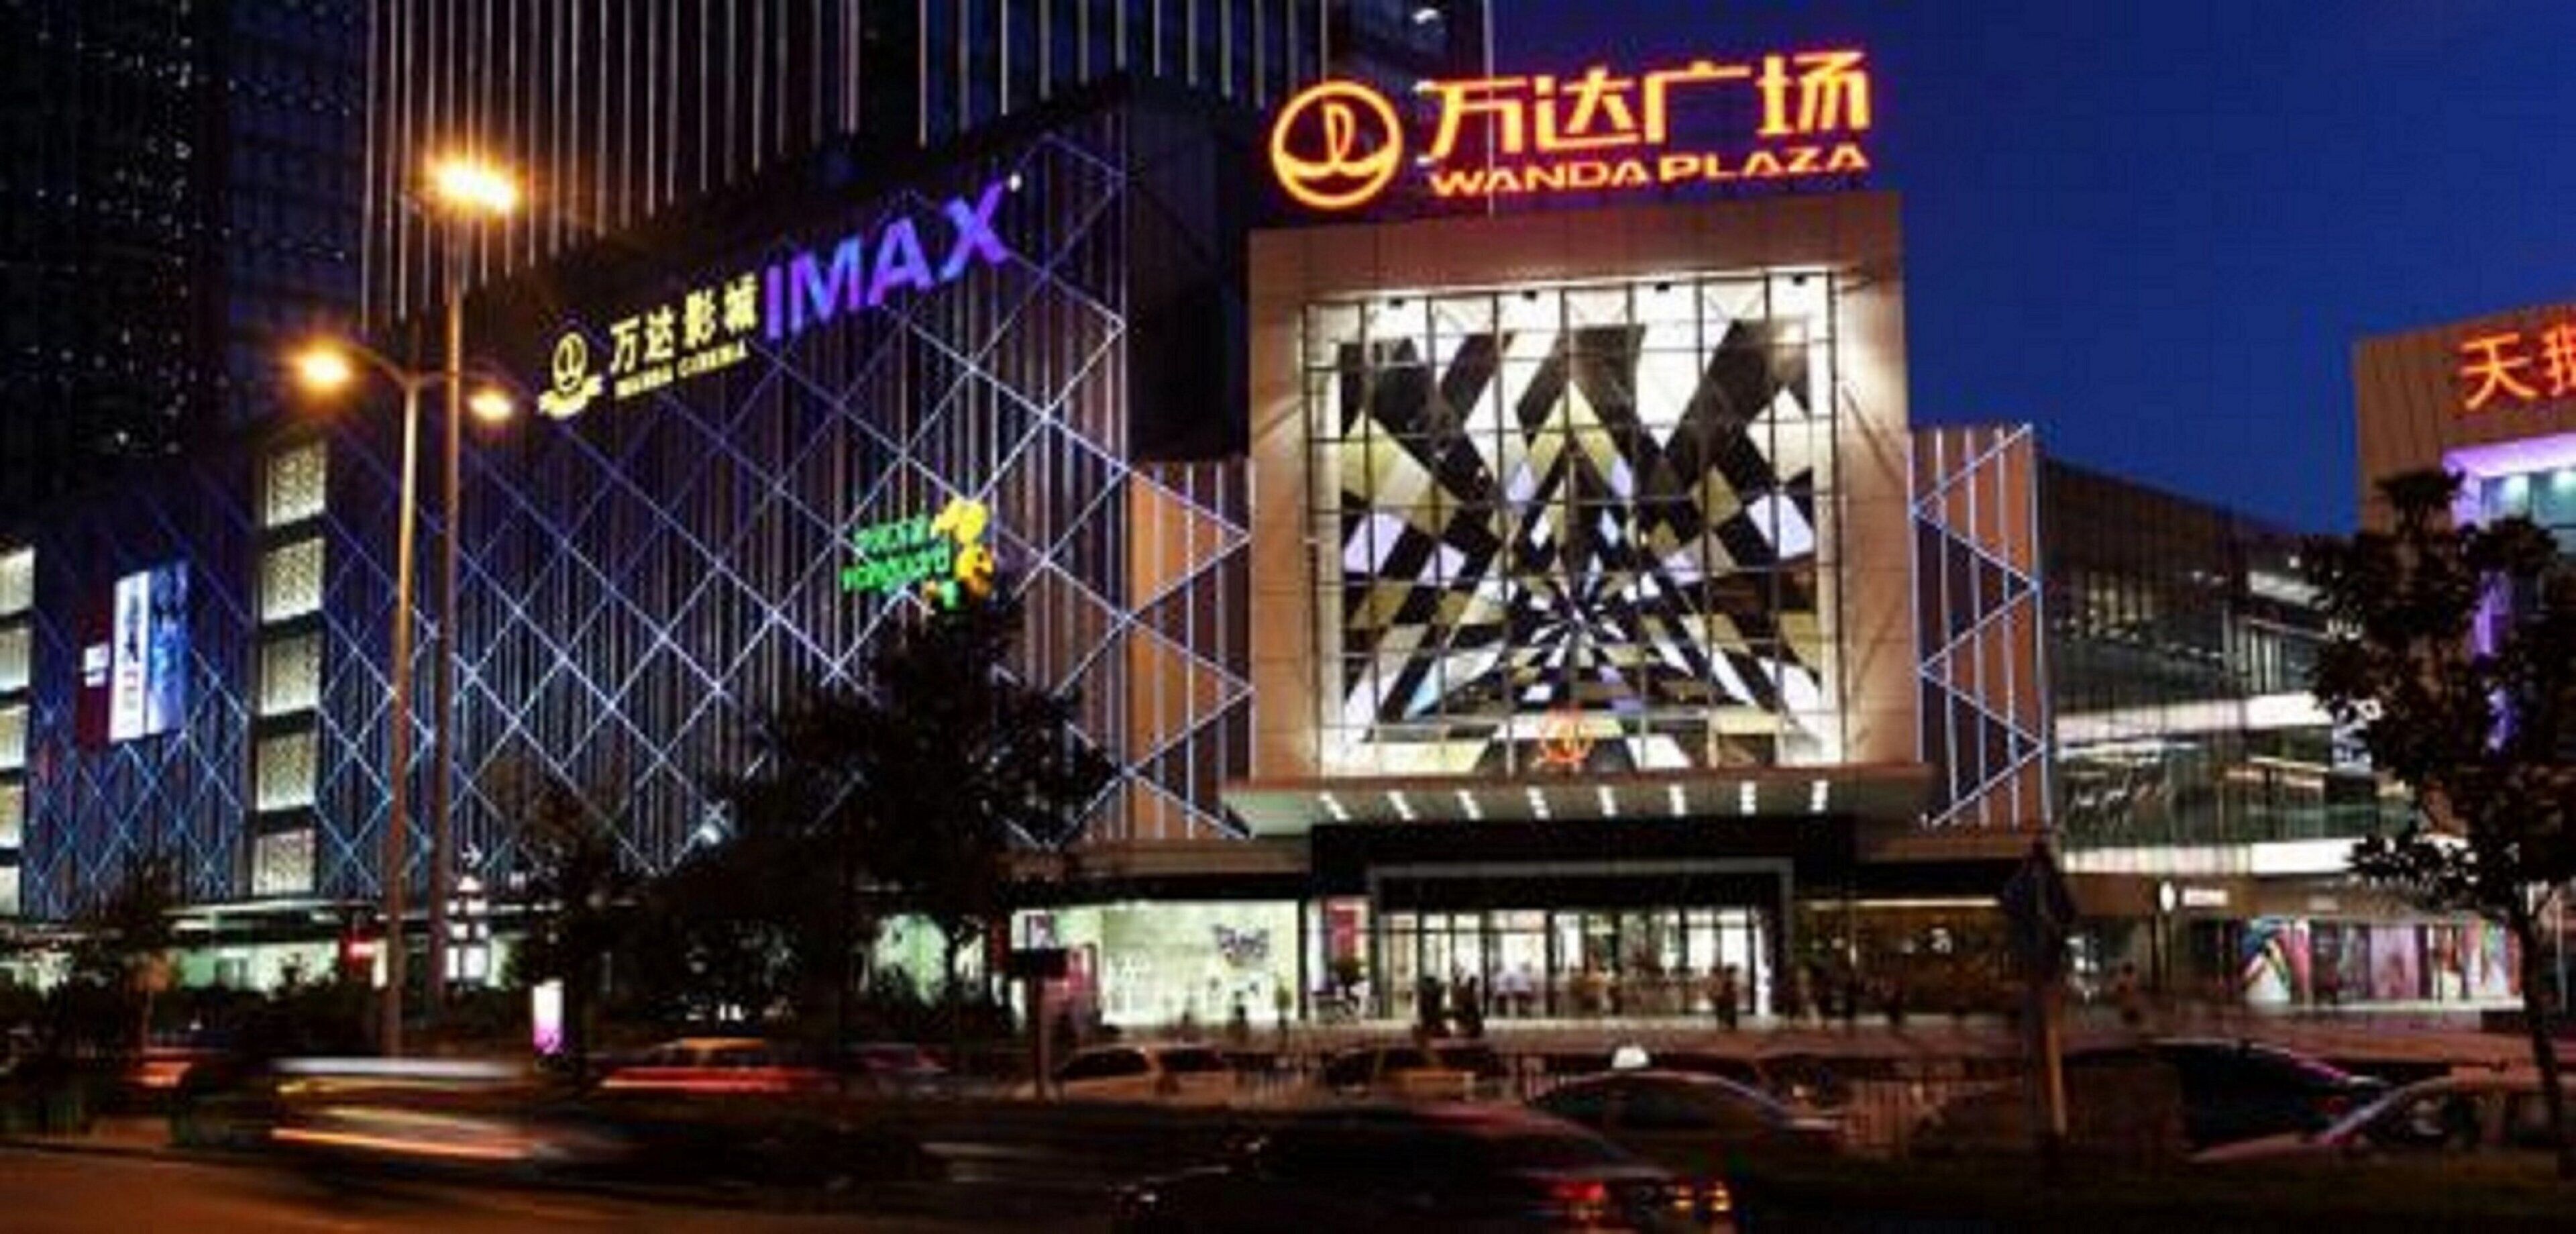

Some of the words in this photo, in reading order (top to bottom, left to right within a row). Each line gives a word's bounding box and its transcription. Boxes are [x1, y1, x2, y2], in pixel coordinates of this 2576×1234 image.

[1426, 51, 1871, 158] 万达广场
[1429, 158, 1650, 196] WANDA
[1658, 143, 1870, 182] PLAZA
[765, 180, 1007, 339] IMAX
